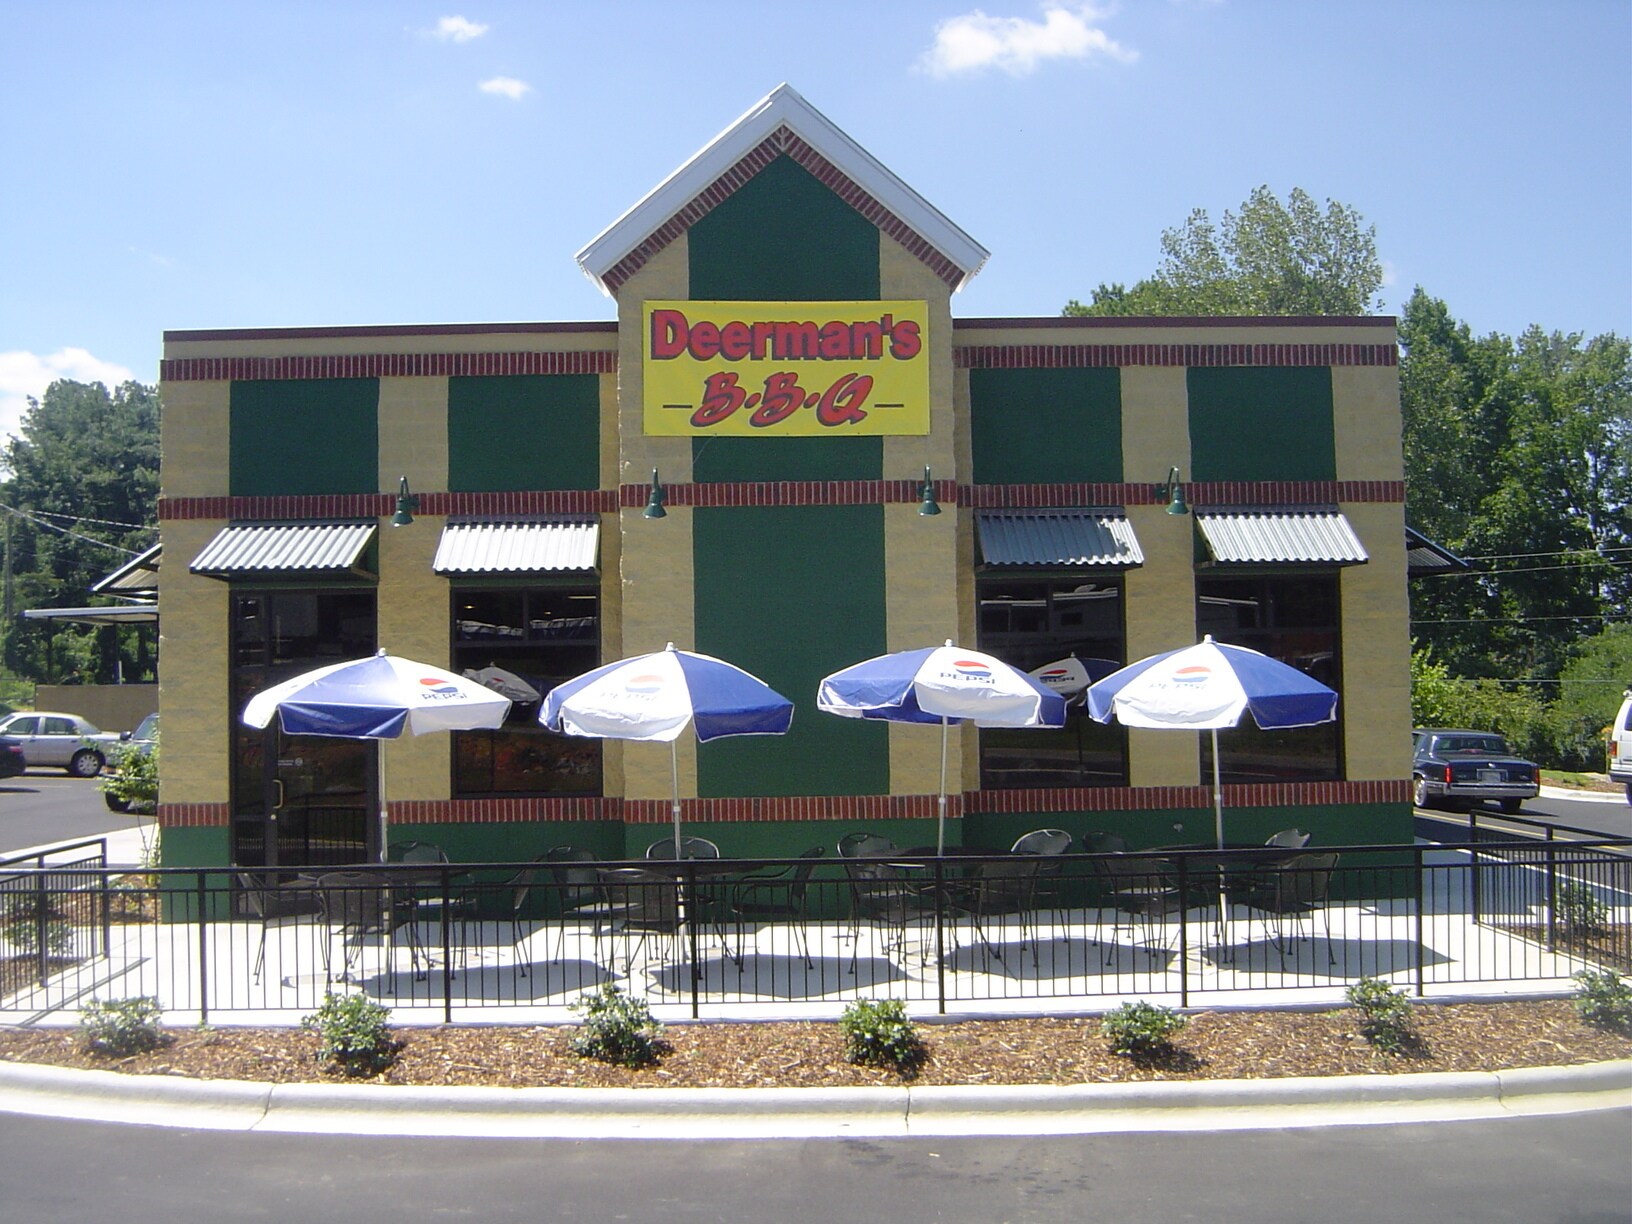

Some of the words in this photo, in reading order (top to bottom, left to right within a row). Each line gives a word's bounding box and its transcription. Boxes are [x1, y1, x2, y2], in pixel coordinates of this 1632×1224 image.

[651, 309, 922, 361] Deerman's
[940, 672, 995, 685] PEPSI
[420, 692, 468, 700] PEPSI
